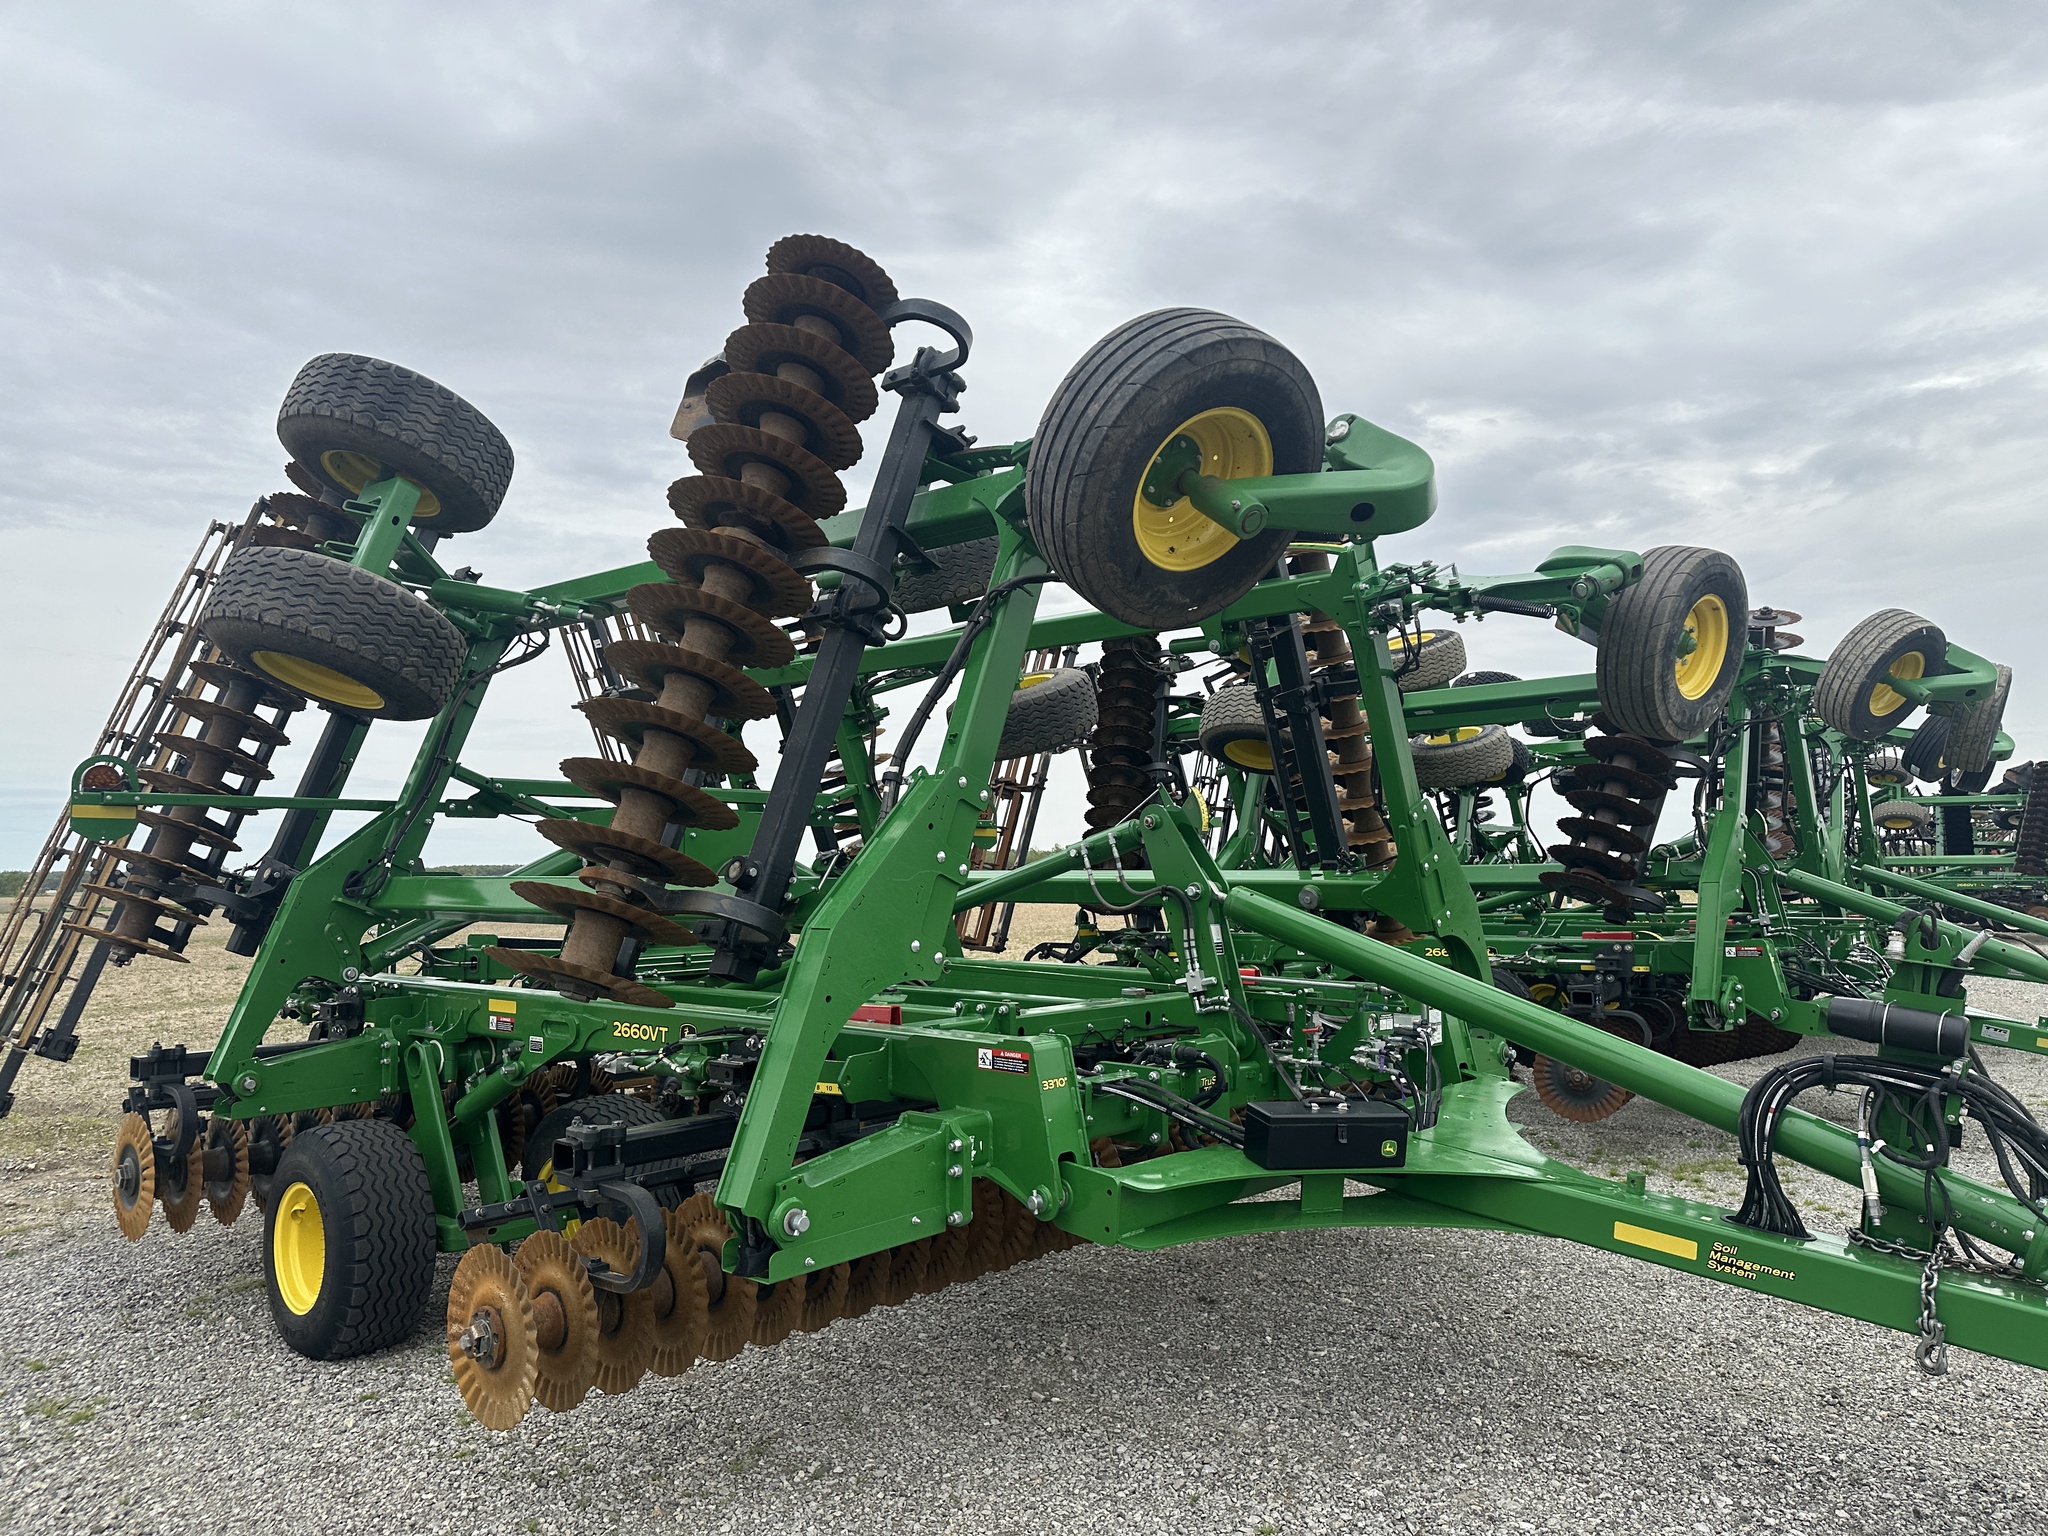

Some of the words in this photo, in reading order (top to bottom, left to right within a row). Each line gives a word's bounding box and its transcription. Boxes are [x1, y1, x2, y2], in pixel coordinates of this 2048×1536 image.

[1424, 947, 1450, 957] 266
[613, 1021, 669, 1043] 2660VT
[1004, 1051, 1022, 1059] DANGER
[1200, 1075, 1217, 1087] TruS
[1712, 1241, 1739, 1255] Soil
[1706, 1259, 1757, 1281] System
[1709, 1250, 1796, 1281] Management
